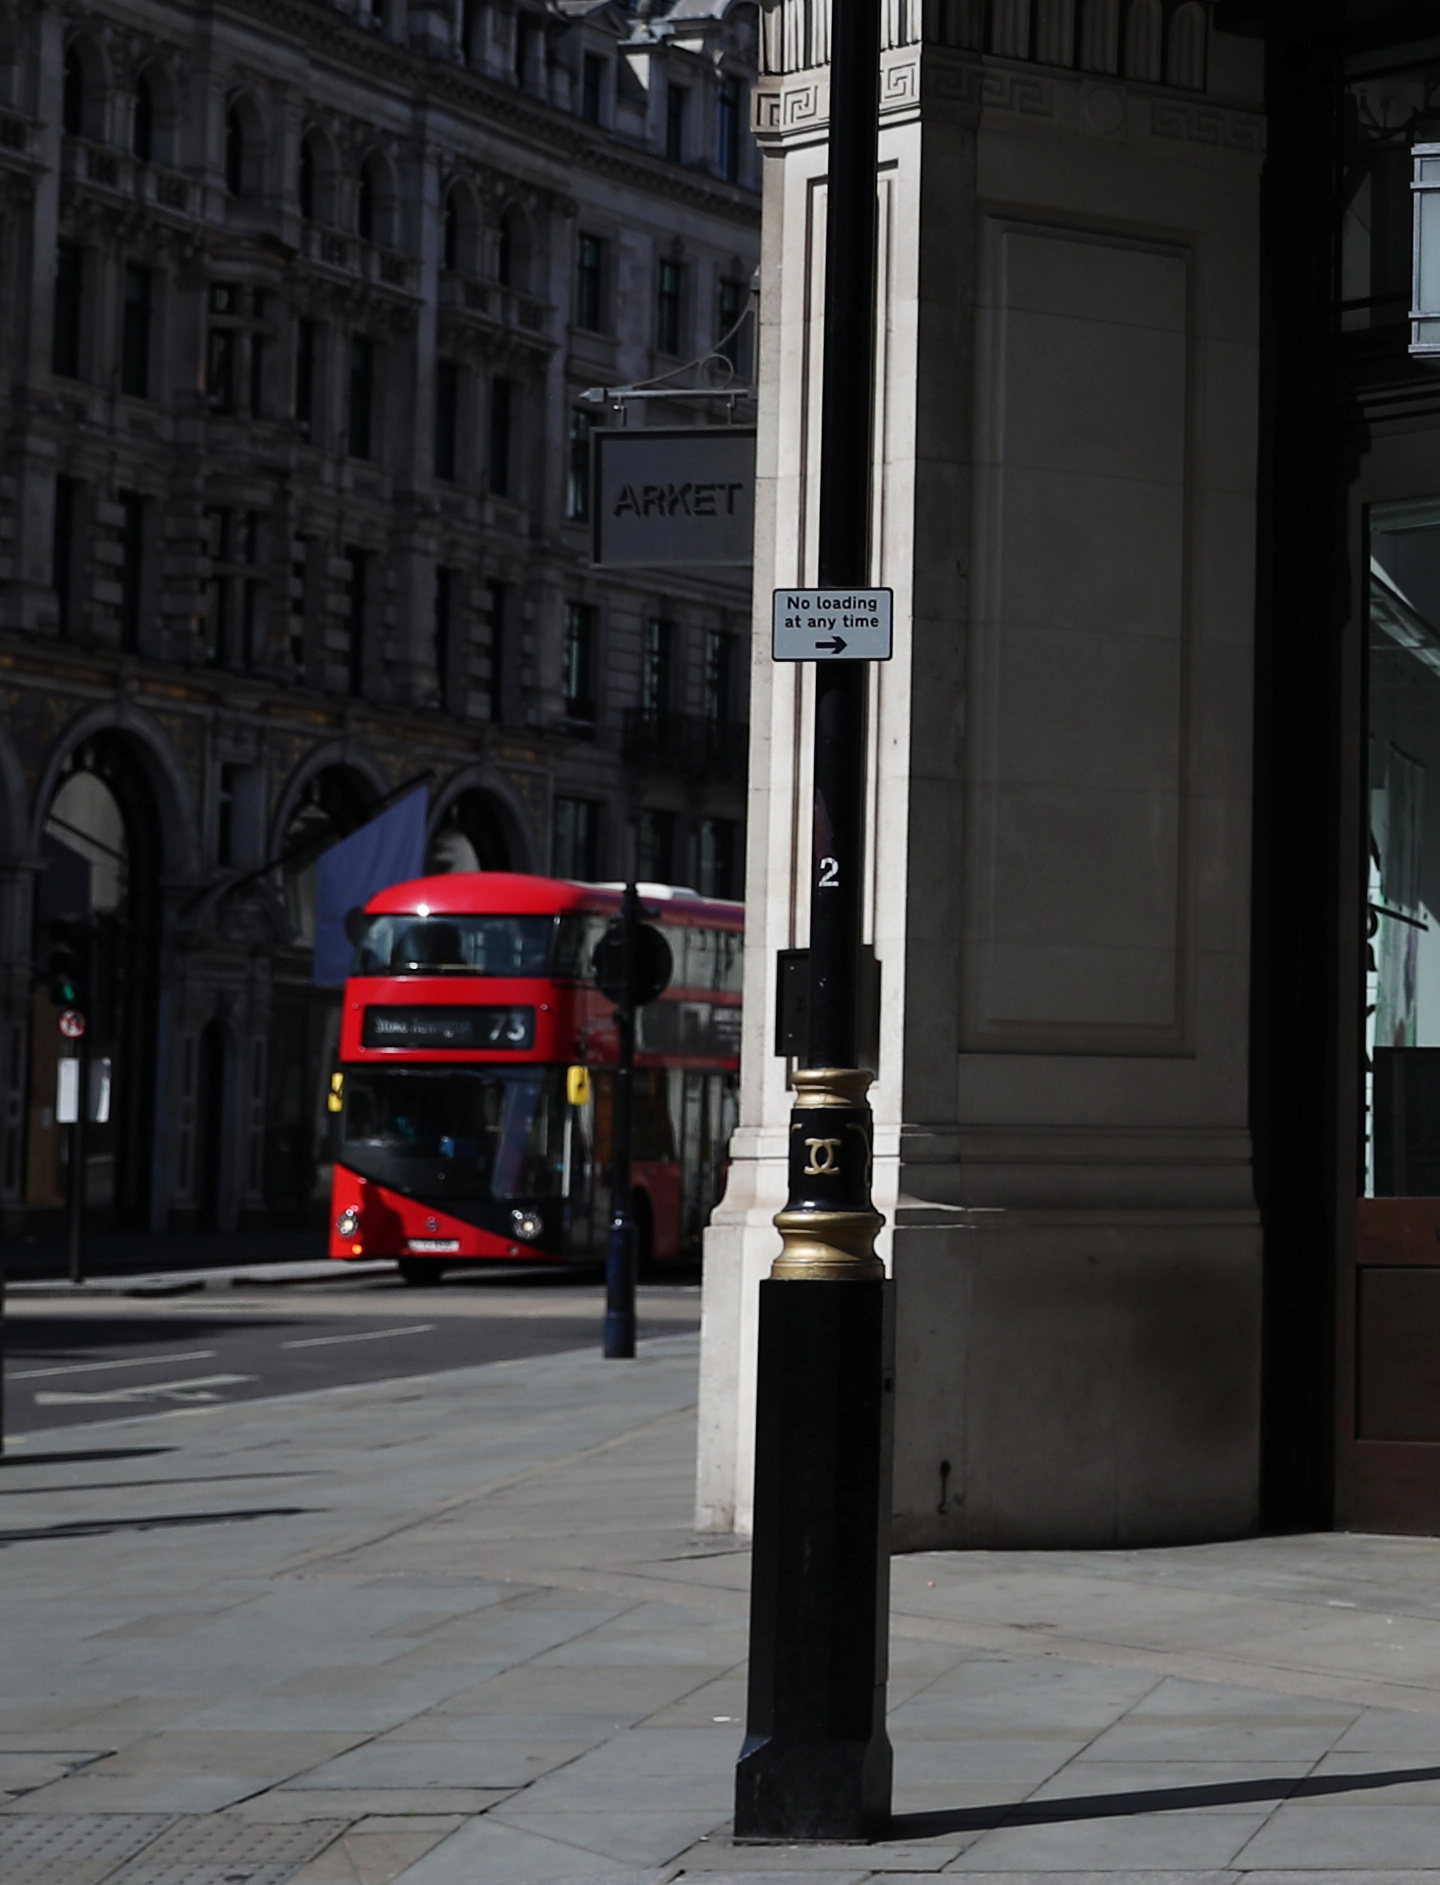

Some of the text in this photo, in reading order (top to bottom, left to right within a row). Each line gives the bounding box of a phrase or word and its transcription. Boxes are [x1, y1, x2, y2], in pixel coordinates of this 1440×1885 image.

[613, 482, 744, 518] ARKET
[787, 596, 877, 612] No loading
[785, 615, 879, 631] at any time
[819, 857, 839, 887] 2
